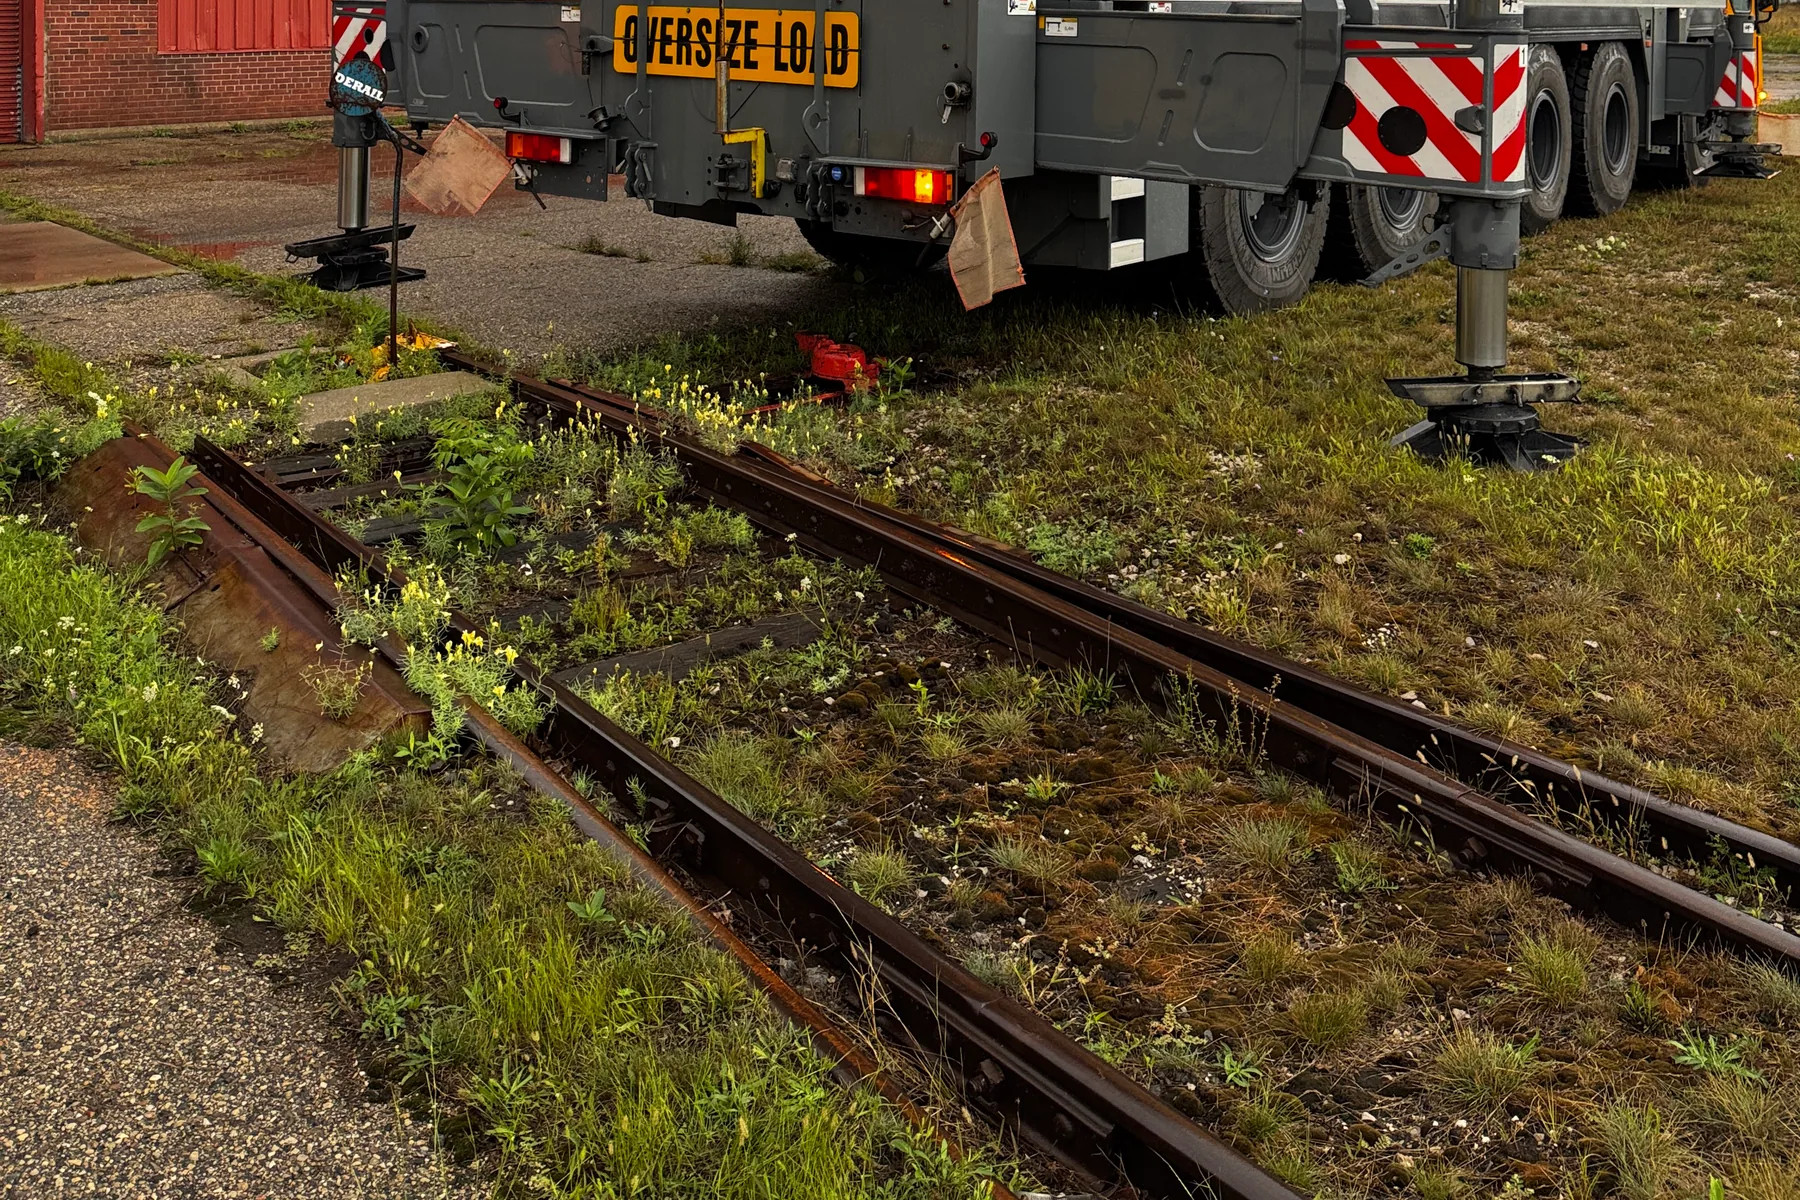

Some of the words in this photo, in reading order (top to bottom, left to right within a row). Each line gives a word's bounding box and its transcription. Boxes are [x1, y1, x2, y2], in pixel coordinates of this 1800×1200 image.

[622, 14, 759, 70] OVERSIZE
[1521, 47, 1526, 65] 1
[335, 71, 384, 102] DERAIL
